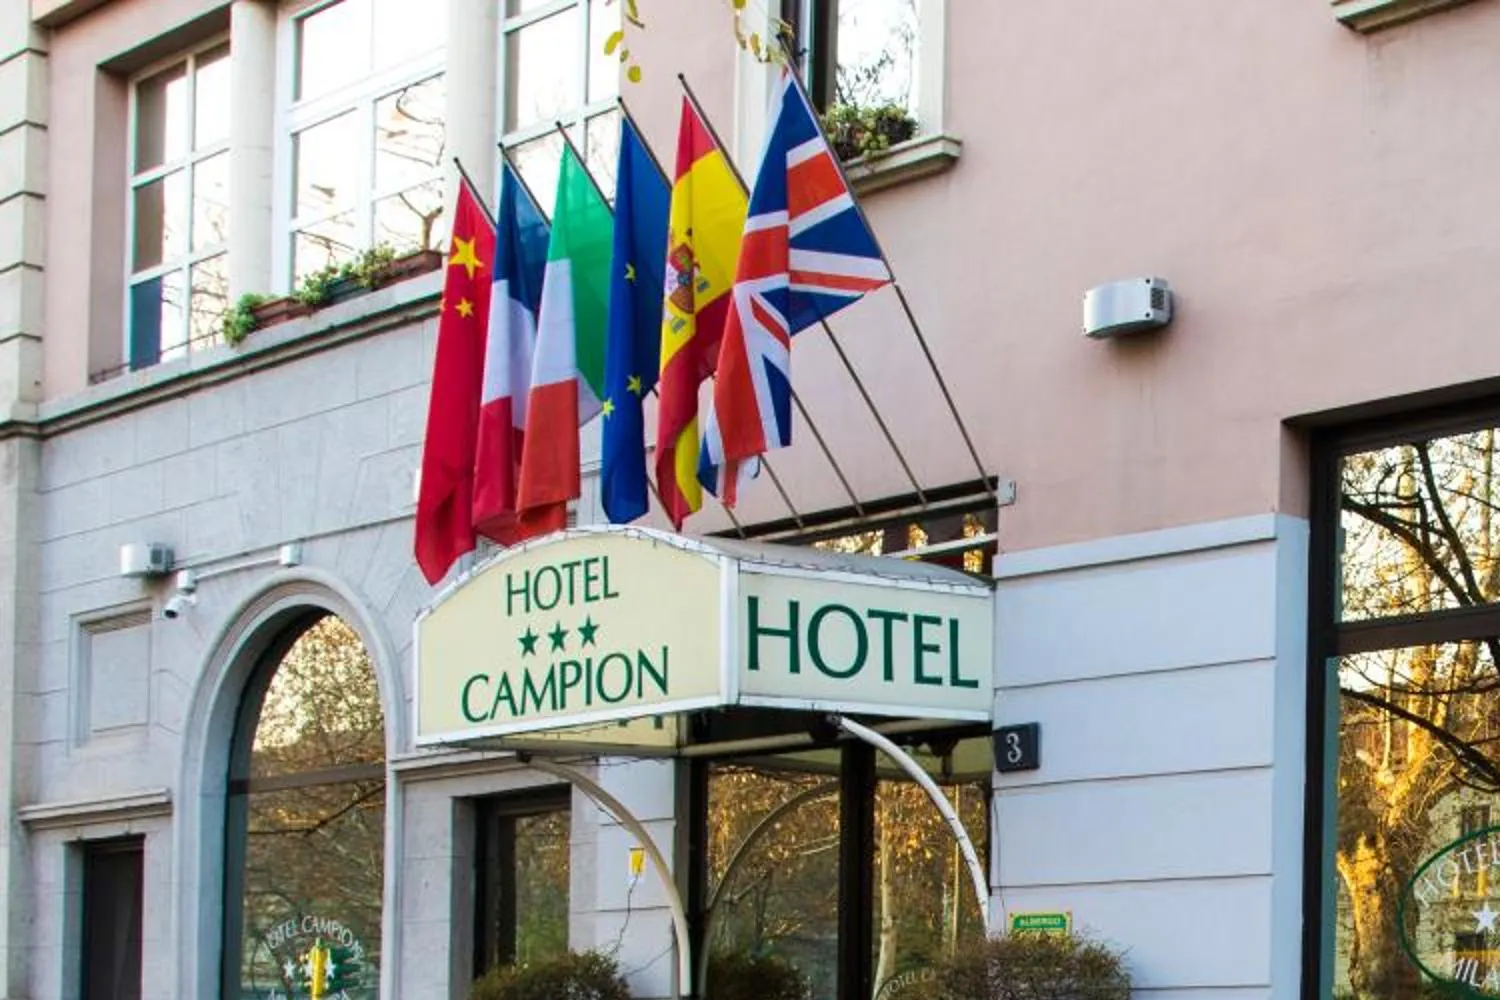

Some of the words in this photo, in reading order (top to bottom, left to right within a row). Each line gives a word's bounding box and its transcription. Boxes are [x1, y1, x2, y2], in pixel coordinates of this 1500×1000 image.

[505, 555, 620, 617] HOTEL
[746, 595, 980, 690] HOTEL
[461, 645, 669, 724] CAMPION
[1006, 732, 1022, 763] 3
